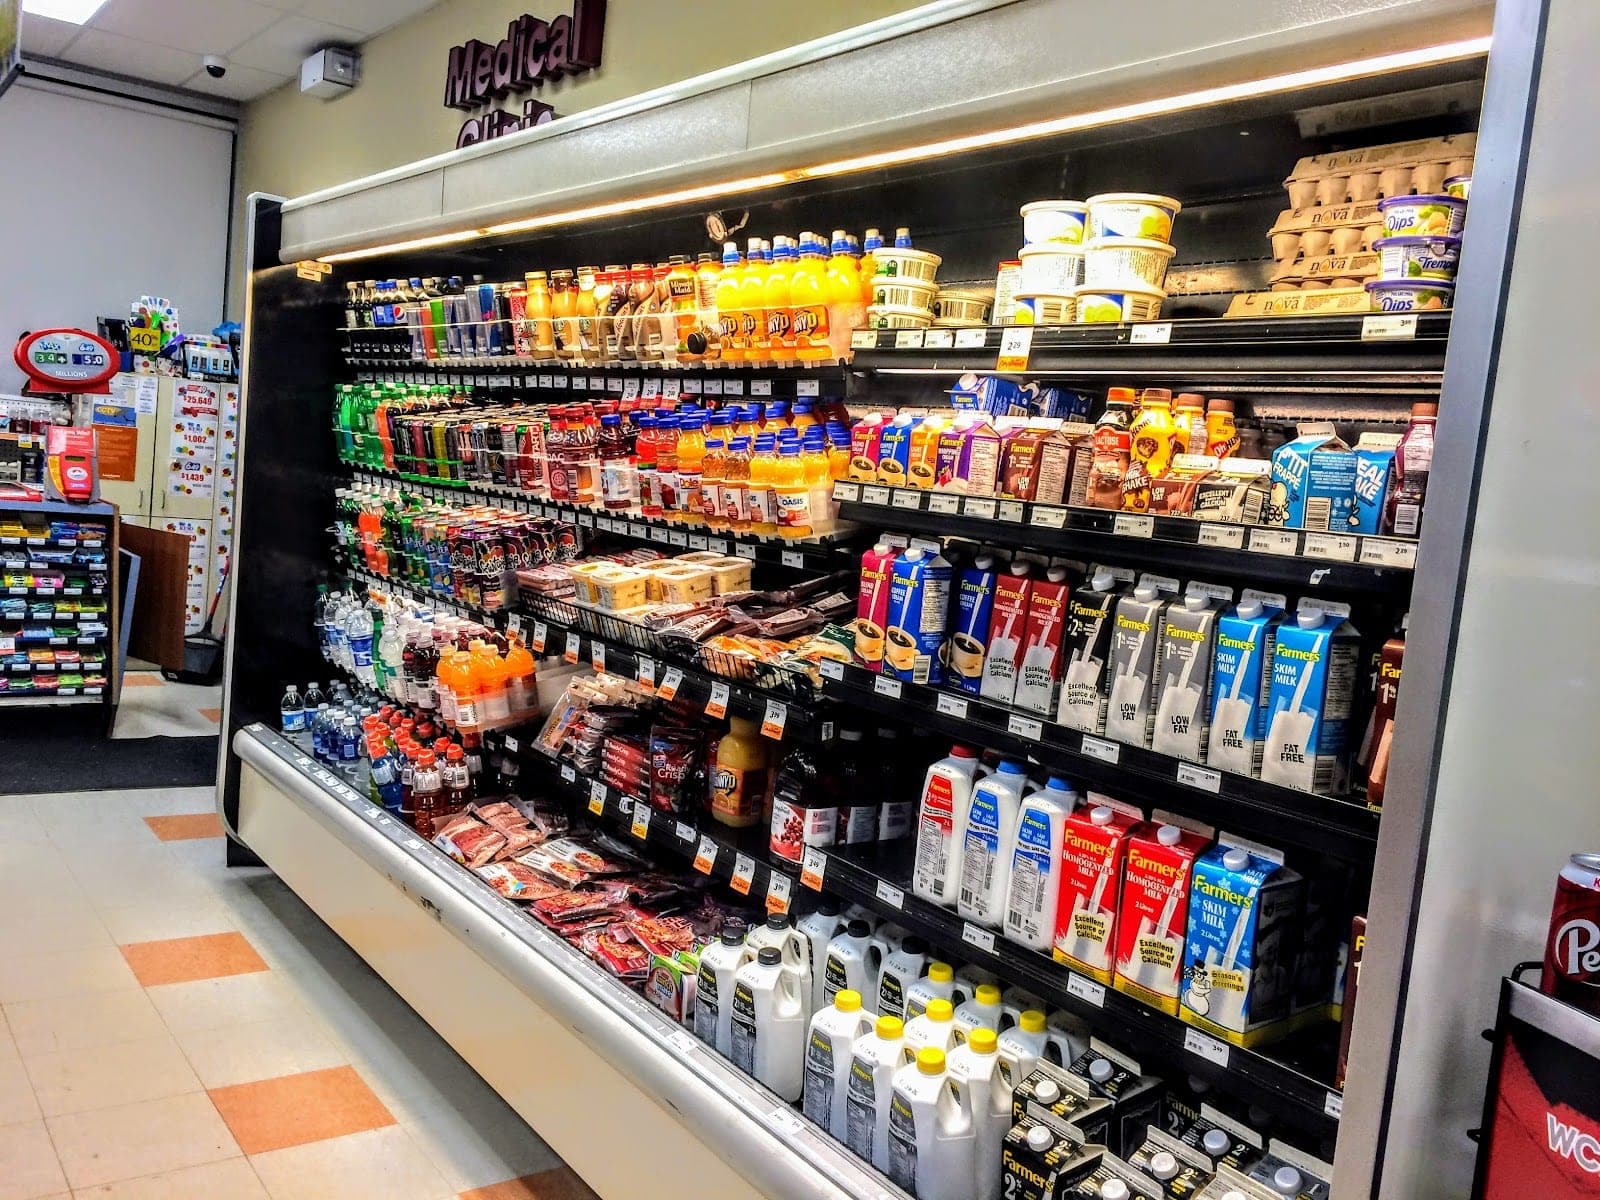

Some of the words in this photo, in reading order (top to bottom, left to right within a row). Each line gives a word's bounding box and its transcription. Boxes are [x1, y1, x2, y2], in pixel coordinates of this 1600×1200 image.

[444, 0, 606, 111] Medical
[1312, 208, 1348, 223] nova
[1388, 215, 1415, 231] Dips
[1310, 258, 1346, 271] nova
[674, 286, 691, 294] Maid
[1263, 297, 1299, 310] nova
[1381, 297, 1414, 311] Dips
[132, 333, 152, 346] 40
[940, 436, 966, 447] Farmers
[1011, 442, 1036, 454] Farmers
[1095, 436, 1119, 446] LACTOSE
[1356, 455, 1386, 487] EAL
[1152, 487, 1165, 495] LOW
[781, 498, 803, 506] OASIS
[861, 566, 887, 581] Farmers
[892, 573, 919, 588] Farmers
[961, 579, 990, 595] Farmers
[996, 585, 1025, 601] Farmers
[1031, 591, 1062, 608] Farmers
[1073, 602, 1108, 619] Farmers
[1117, 614, 1152, 632] Farmers
[1166, 623, 1206, 642] Farmers
[1217, 633, 1256, 652] Farmers
[1216, 652, 1236, 665] SKIM
[1276, 643, 1321, 663] Farmers
[990, 670, 1012, 679] Calcium
[1025, 665, 1051, 675] Excellent
[1217, 662, 1236, 675] MILK
[1274, 662, 1297, 676] SKIM
[1381, 662, 1402, 679] Far
[1025, 672, 1044, 680] Source
[1044, 675, 1051, 683] of
[1025, 679, 1048, 689] Calcium
[1275, 674, 1297, 687] MILK
[1068, 682, 1098, 693] Excellent
[1068, 690, 1090, 699] Source
[1090, 692, 1097, 700] of
[1068, 697, 1095, 708] Calcium
[1120, 702, 1136, 713] LOW
[1122, 710, 1135, 721] FAT
[1171, 715, 1190, 726] LOW
[1173, 723, 1188, 734] FAT
[1224, 729, 1238, 740] FAT
[1222, 738, 1244, 750] FREE
[1283, 743, 1299, 754] FAT
[1280, 752, 1305, 764] FREE
[657, 768, 686, 782] Crisp
[665, 763, 690, 773] Ready
[975, 797, 994, 812] Farmers
[1024, 815, 1047, 830] Farmers
[1064, 828, 1114, 859] Farmers
[1062, 849, 1114, 876] HOMOGENIZED
[1128, 848, 1186, 881] Farmers
[1077, 865, 1095, 879] MILK
[1126, 870, 1185, 899] HOMOGENIZED
[1143, 887, 1164, 901] MILK
[1193, 874, 1252, 910] Farmers
[1202, 899, 1228, 918] SKIM
[1074, 914, 1105, 929] Excellent
[1202, 913, 1226, 930] MILK
[1074, 922, 1097, 936] Source
[1097, 927, 1106, 937] of
[1075, 929, 1103, 943] Calcium
[1139, 939, 1175, 954] Excellent
[1555, 918, 1600, 976] Pe
[1139, 947, 1165, 962] Source
[1165, 953, 1176, 963] of
[1141, 955, 1172, 969] Calcium
[1211, 970, 1243, 983] Season's
[1211, 978, 1245, 993] Greetings
[1547, 1112, 1600, 1175] WC
[1003, 1149, 1054, 1194] Farmers
